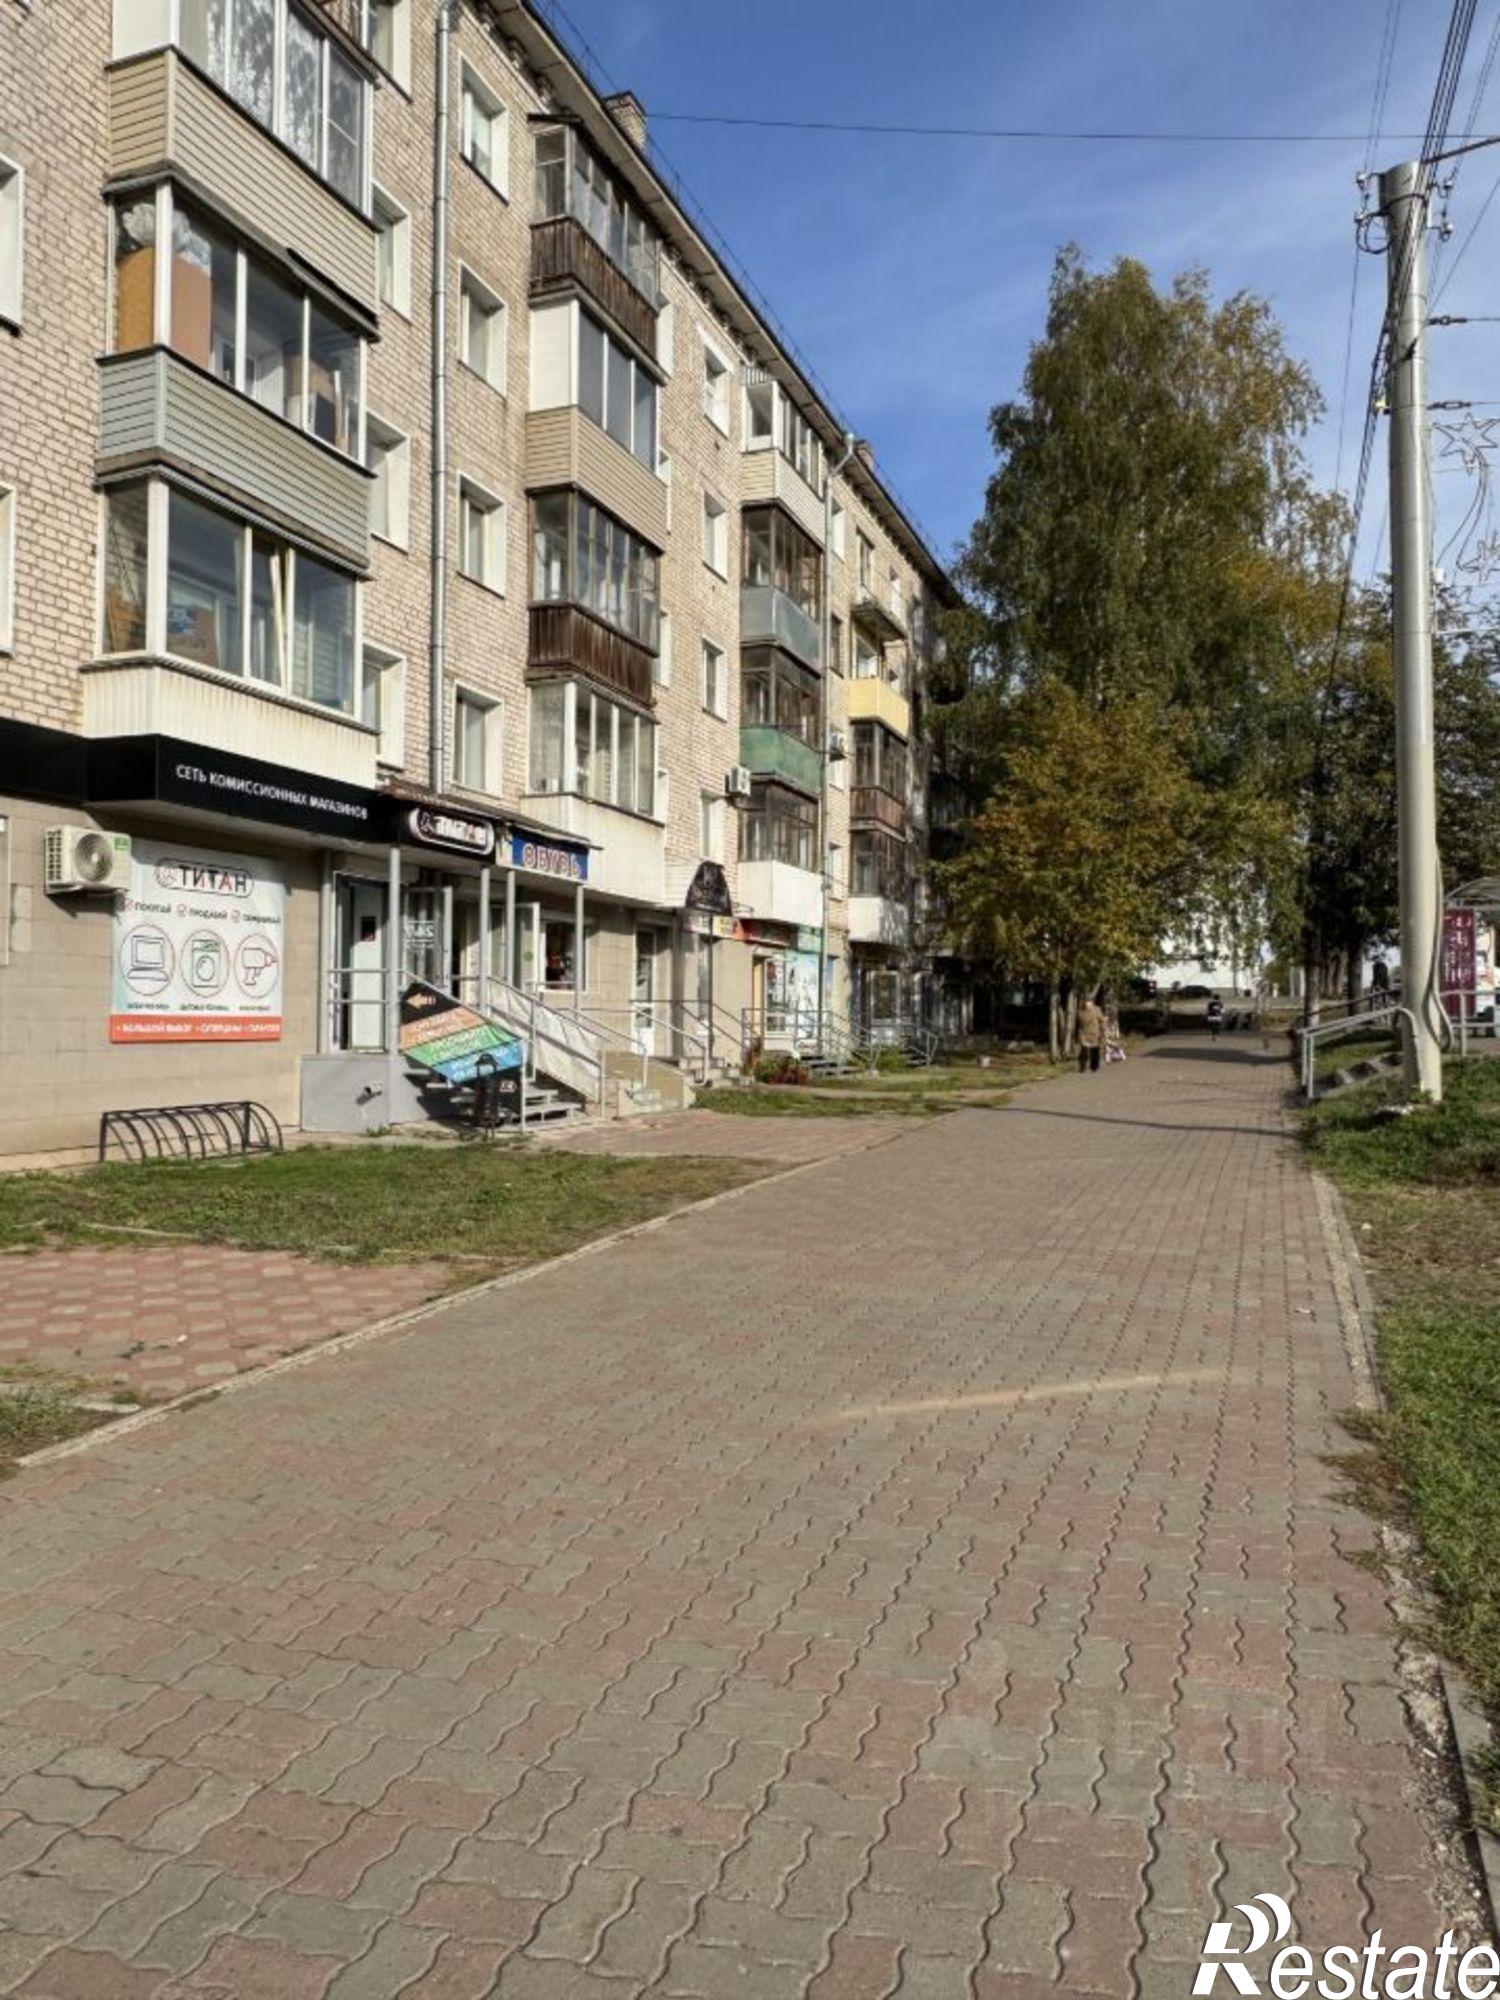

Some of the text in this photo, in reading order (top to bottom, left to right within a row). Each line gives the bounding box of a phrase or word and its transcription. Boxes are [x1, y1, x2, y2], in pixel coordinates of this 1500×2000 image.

[176, 764, 368, 820] СЕТЬ КОМИССИОННЫХ МАГАЗИНОВ
[522, 841, 582, 878] ОБУВЬ
[178, 864, 247, 893] ТИТАН
[135, 901, 172, 914] ПОКУПАЙ
